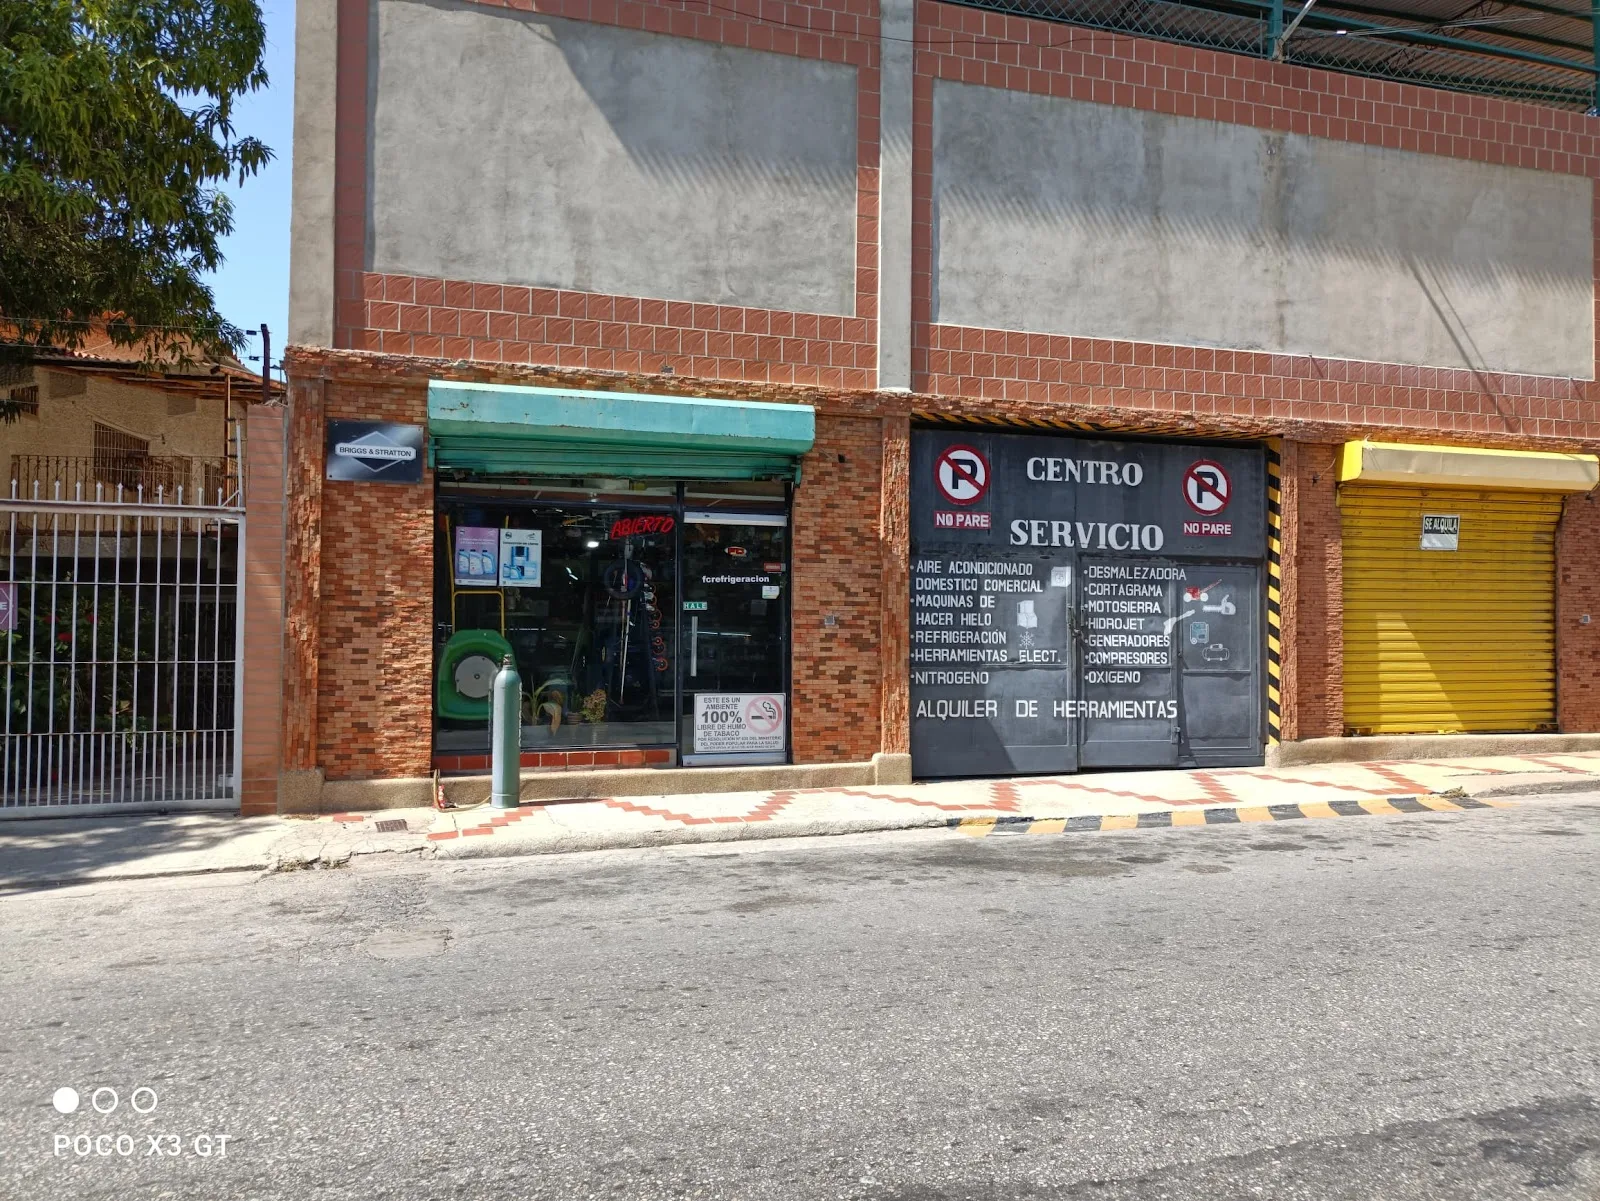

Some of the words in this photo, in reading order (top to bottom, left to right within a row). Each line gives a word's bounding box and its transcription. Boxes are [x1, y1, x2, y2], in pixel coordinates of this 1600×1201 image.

[339, 446, 367, 454] BRIGGS
[374, 448, 412, 457] STRATTON
[1026, 456, 1143, 487] CENTRO
[610, 515, 675, 539] ABIERTO
[936, 513, 954, 526] NO
[956, 514, 989, 528] PARE
[1424, 518, 1433, 530] SE
[1433, 517, 1457, 531] ALQUILA
[1009, 519, 1164, 551] SERVICIO
[1183, 522, 1200, 534] NO
[1202, 523, 1232, 535] PARE
[916, 560, 942, 574] AIRE
[948, 561, 1033, 576] ACONDICIONADO
[1088, 565, 1187, 581] DESMALEZADORA
[702, 574, 770, 584] fcrefrigeracion
[915, 577, 978, 591] DOMESTICO
[984, 579, 1044, 593] COMERCIAL
[1088, 583, 1163, 597] CORTAGRAMA
[915, 594, 974, 609] MAQUINAS
[980, 595, 995, 608] DE
[1088, 600, 1162, 614] MOTOSIERRA
[915, 612, 954, 626] HACER
[960, 612, 992, 627] HIELO
[1088, 617, 1145, 630] HIDROJET
[915, 628, 1007, 644] REFRIGERACIÓN
[1088, 634, 1171, 647] GENERADORES
[914, 648, 1008, 662] HERRAMIENTAS
[1019, 649, 1061, 663] ELECT.
[1088, 651, 1168, 664] COMPRESORES
[915, 671, 989, 685] NITROGENO
[1088, 670, 1141, 684] OXIGENO
[701, 710, 743, 723] 100%
[916, 699, 998, 721] ALQUILER
[1015, 699, 1038, 718] DE
[1053, 700, 1178, 719] HERRAMIENTAS
